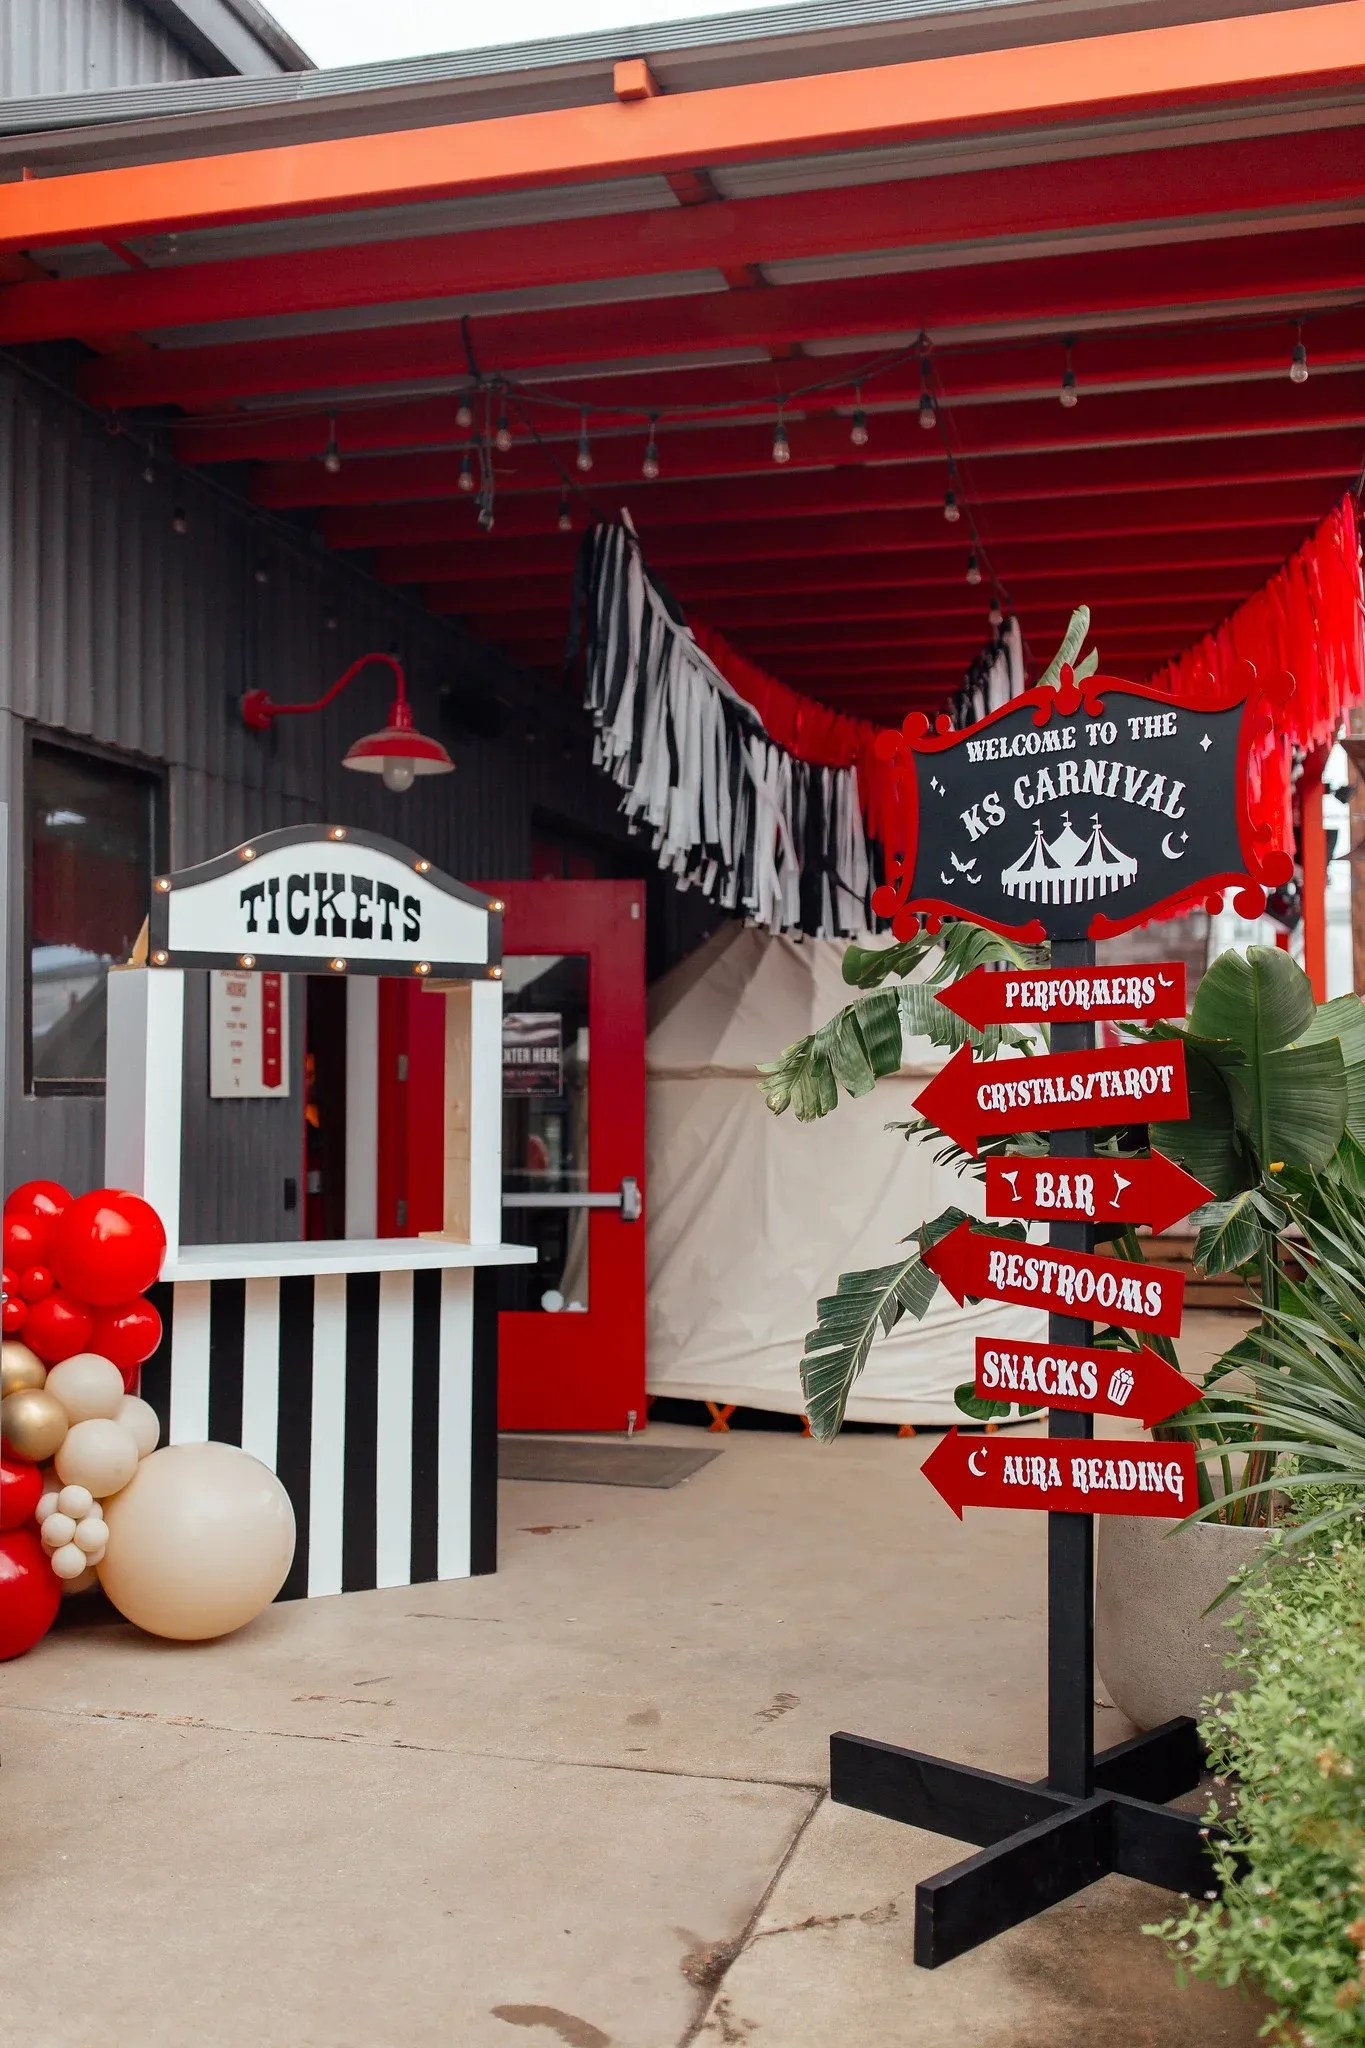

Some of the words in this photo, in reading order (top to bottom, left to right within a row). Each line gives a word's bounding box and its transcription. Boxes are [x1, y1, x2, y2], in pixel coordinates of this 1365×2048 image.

[966, 725, 1076, 764] WELCOME
[1085, 721, 1118, 747] TO
[1127, 711, 1178, 741] THE
[960, 790, 1006, 842] KS
[1013, 758, 1186, 821] CARNIVAL
[240, 872, 421, 943] TICKETS
[1005, 976, 1156, 1012] PERFORMERS
[503, 1047, 531, 1064] NTER
[532, 1047, 560, 1064] HERE
[976, 1065, 1174, 1113] CRYSTALS/TAROT
[1035, 1171, 1096, 1217] BAR
[987, 1250, 1163, 1318] RESTROOMS
[982, 1350, 1099, 1401] SNACKS
[1002, 1455, 1063, 1492] AURA
[1071, 1457, 1186, 1503] READING
